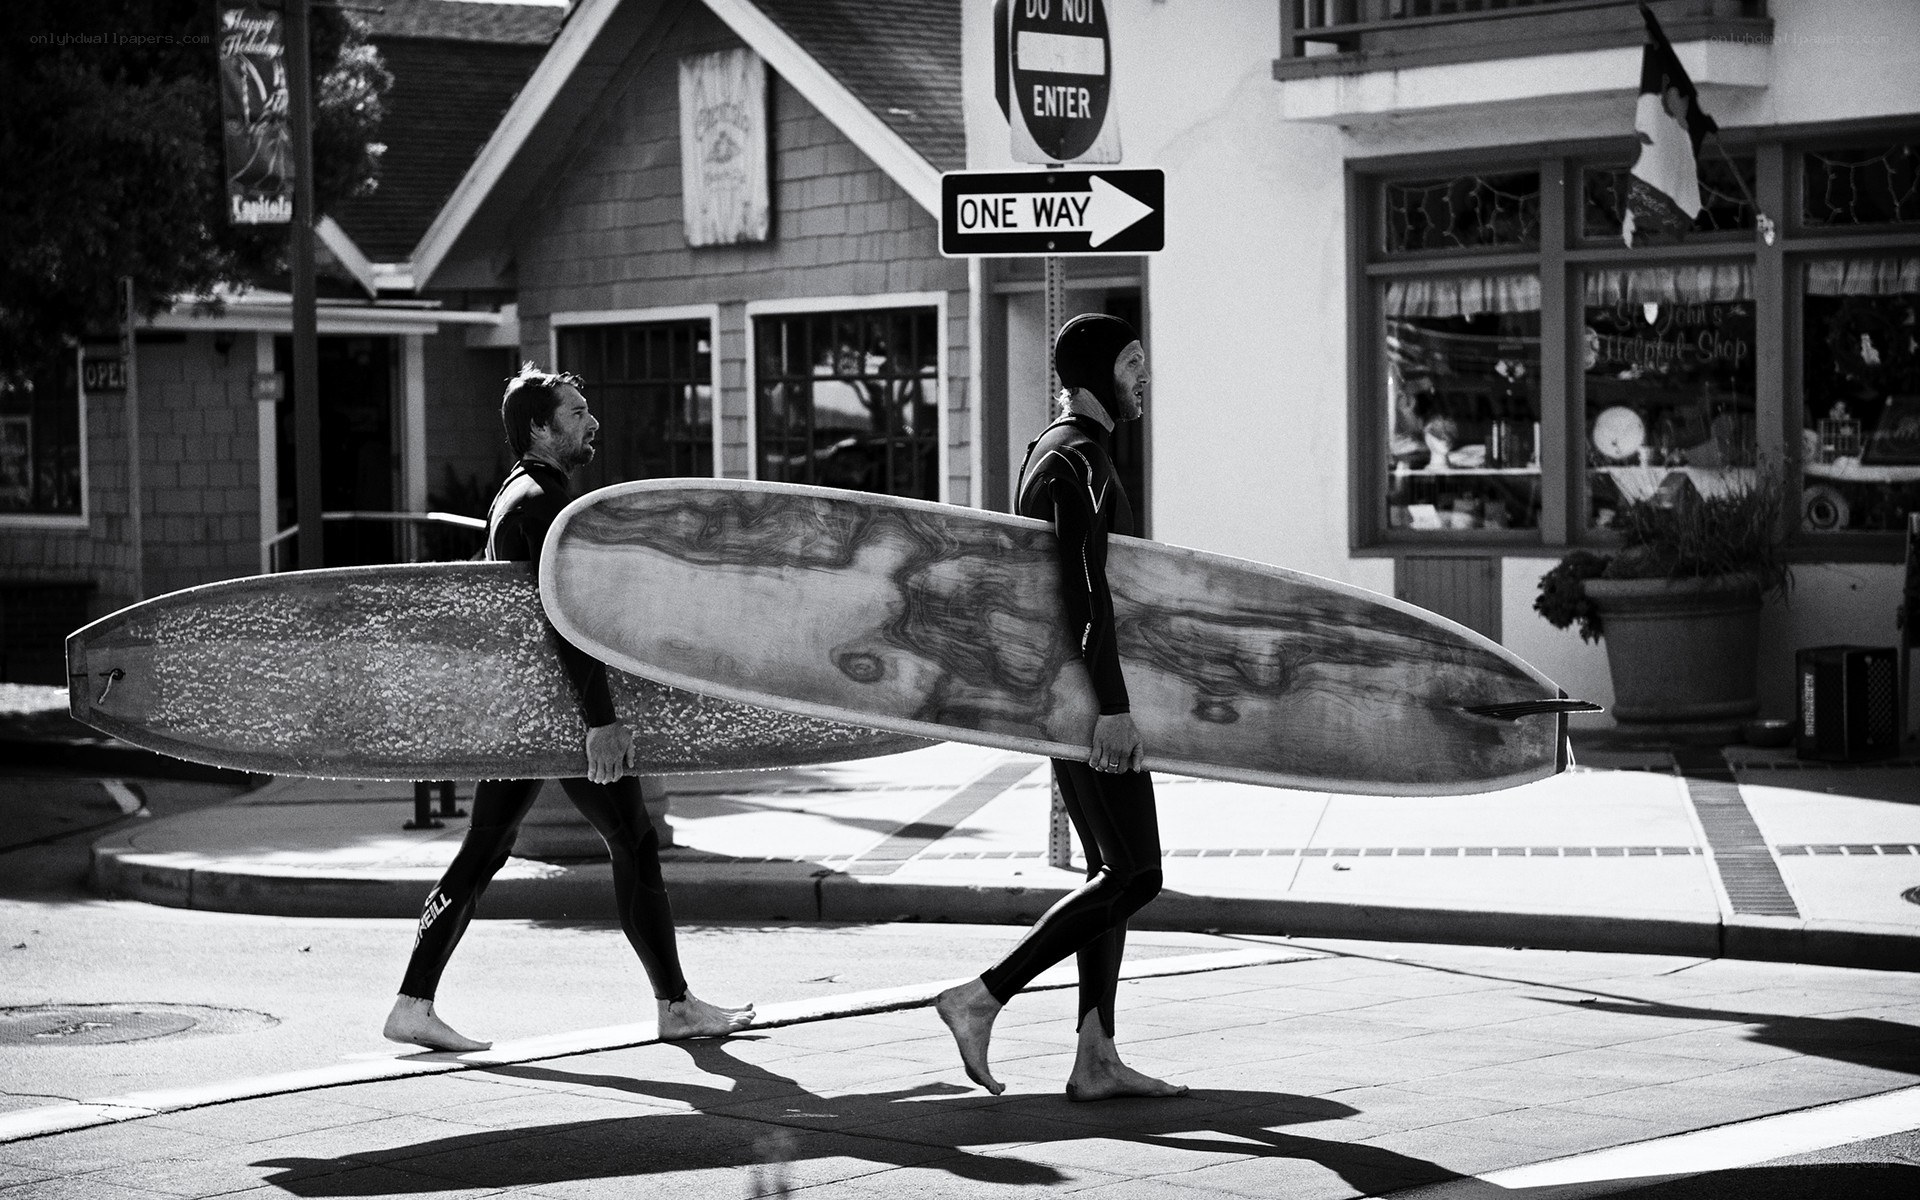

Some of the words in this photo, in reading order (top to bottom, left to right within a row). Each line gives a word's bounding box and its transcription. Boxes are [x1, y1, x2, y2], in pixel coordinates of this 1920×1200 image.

[1025, 0, 1050, 20] DO
[1062, 0, 1094, 24] NOT
[1033, 84, 1092, 119] ENTER
[960, 198, 1018, 229] ONE
[1032, 196, 1091, 228] WAY
[1697, 329, 1748, 369] Shop
